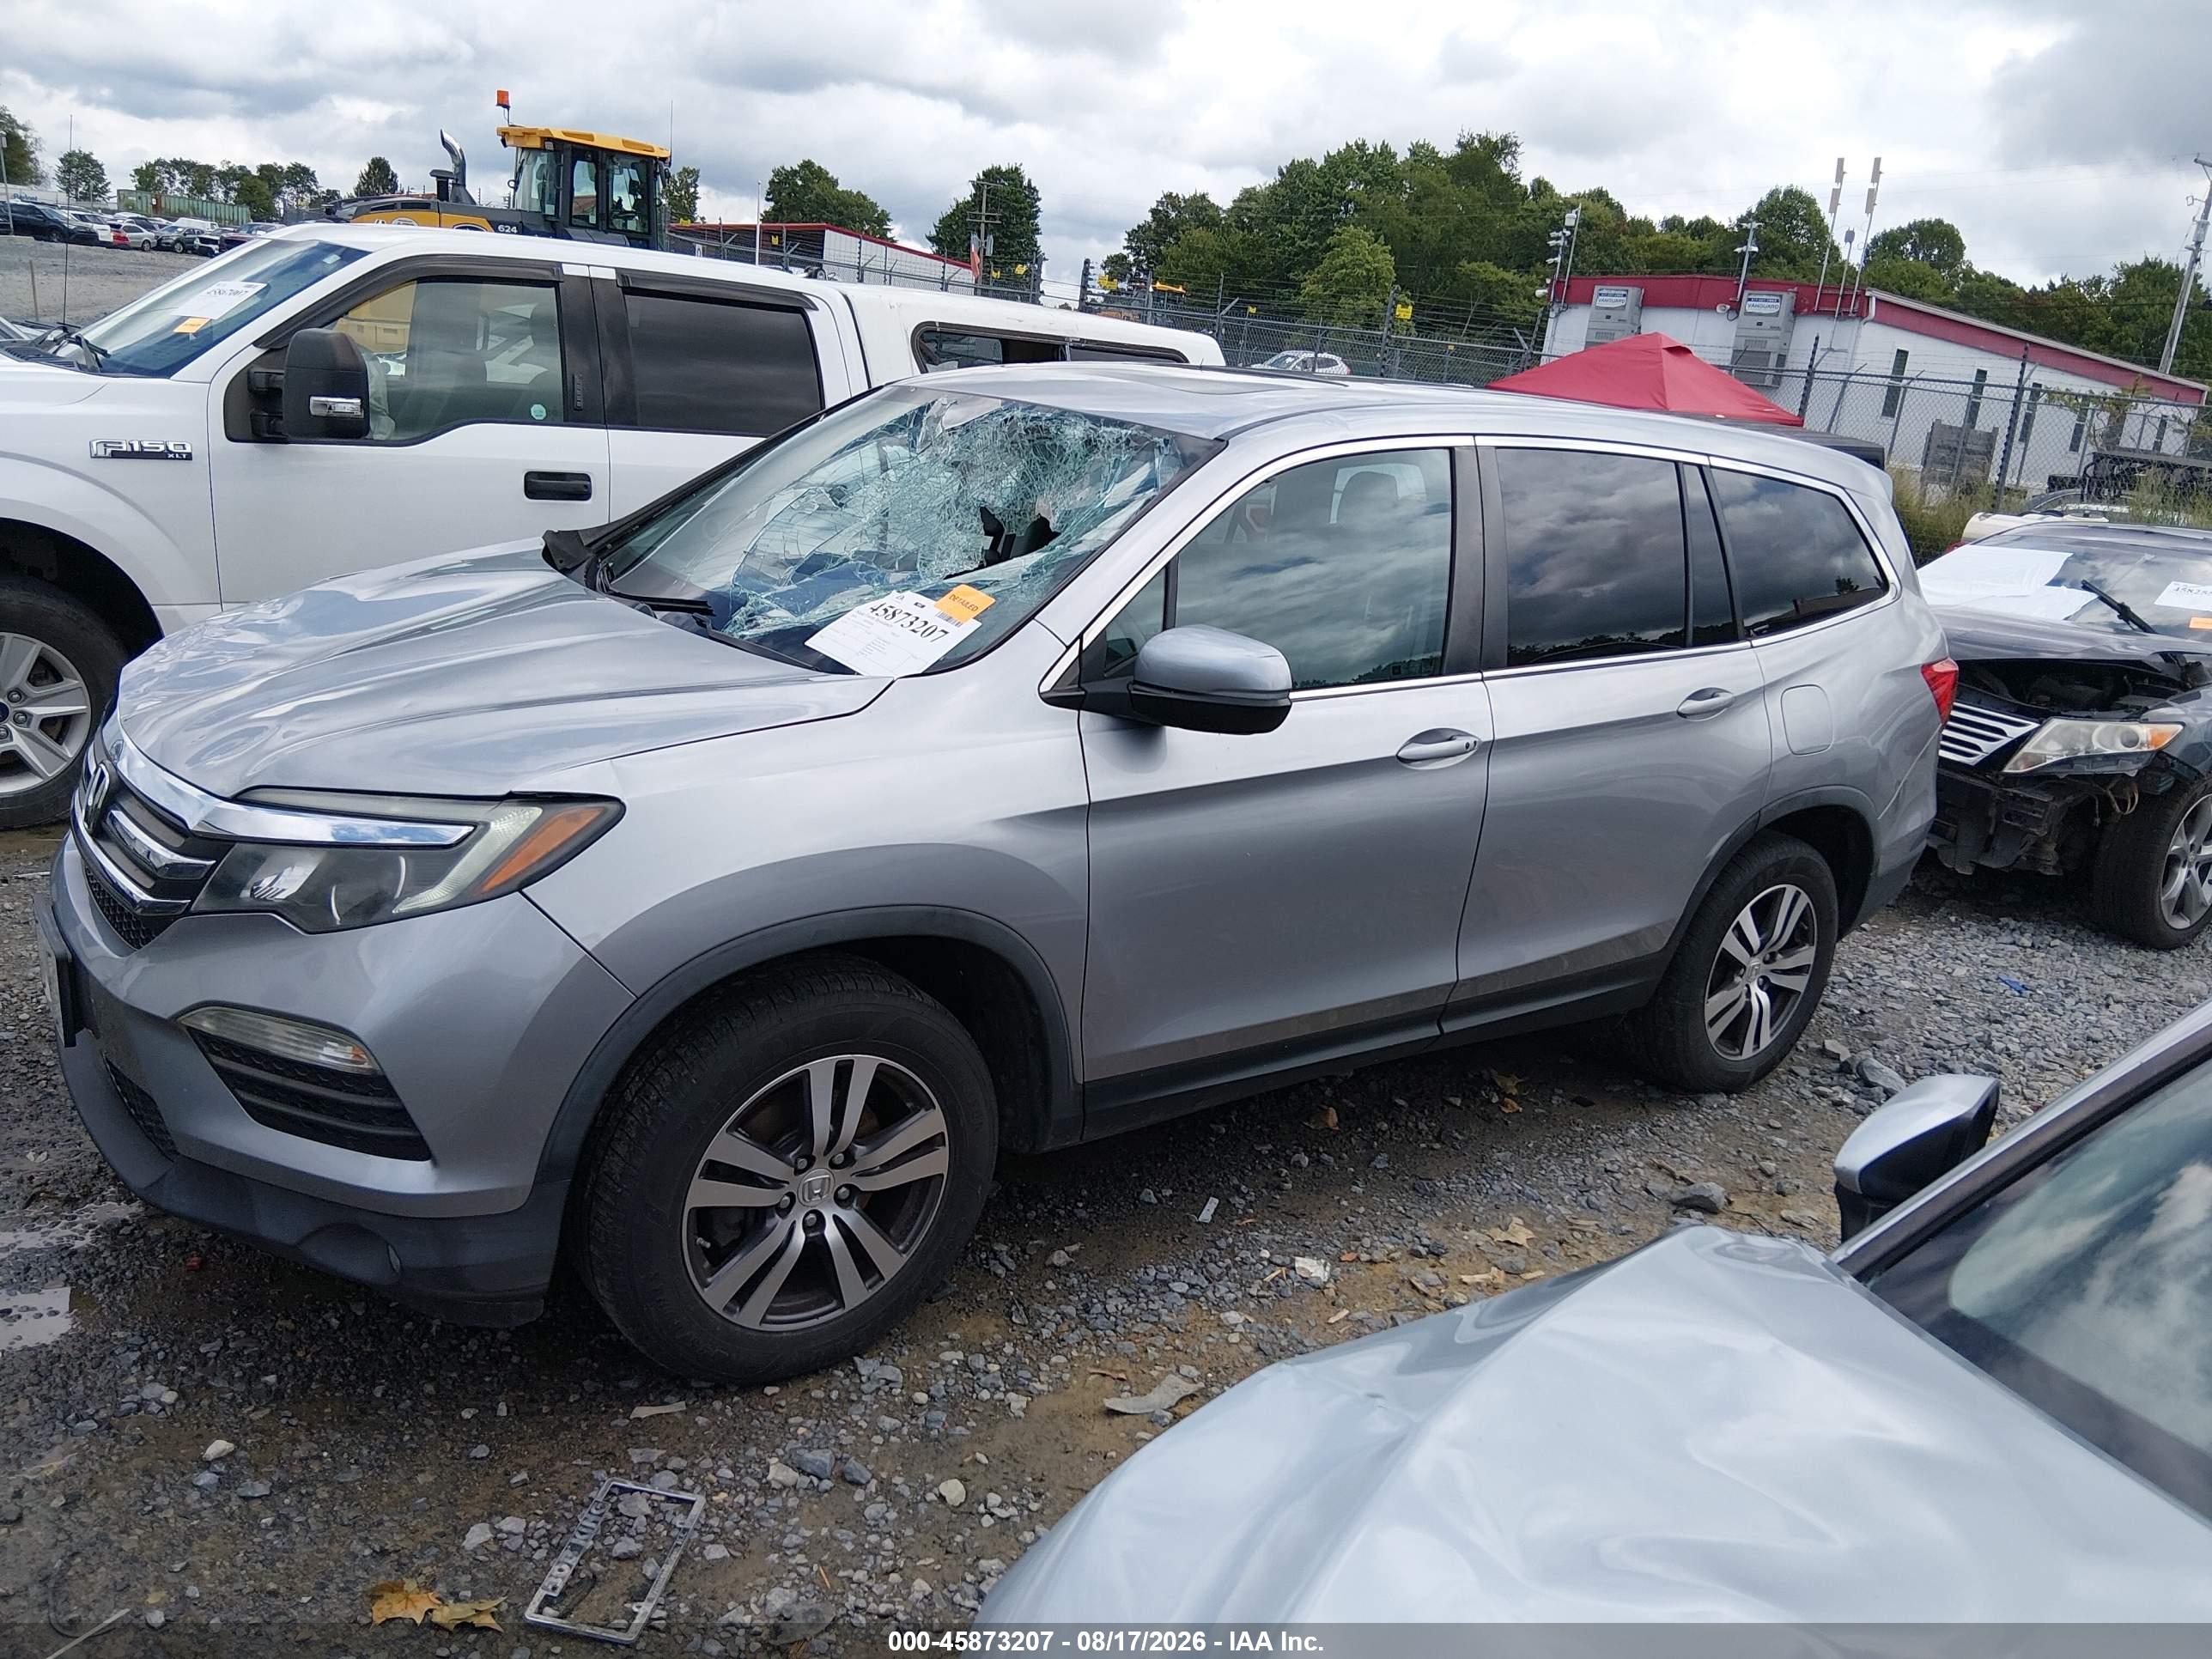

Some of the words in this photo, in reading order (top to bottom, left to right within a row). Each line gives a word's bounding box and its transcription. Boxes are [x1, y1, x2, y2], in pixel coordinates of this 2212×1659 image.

[497, 224, 518, 234] 624
[89, 439, 192, 459] F150
[948, 593, 979, 612] DETAILED
[870, 602, 951, 642] 45873207
